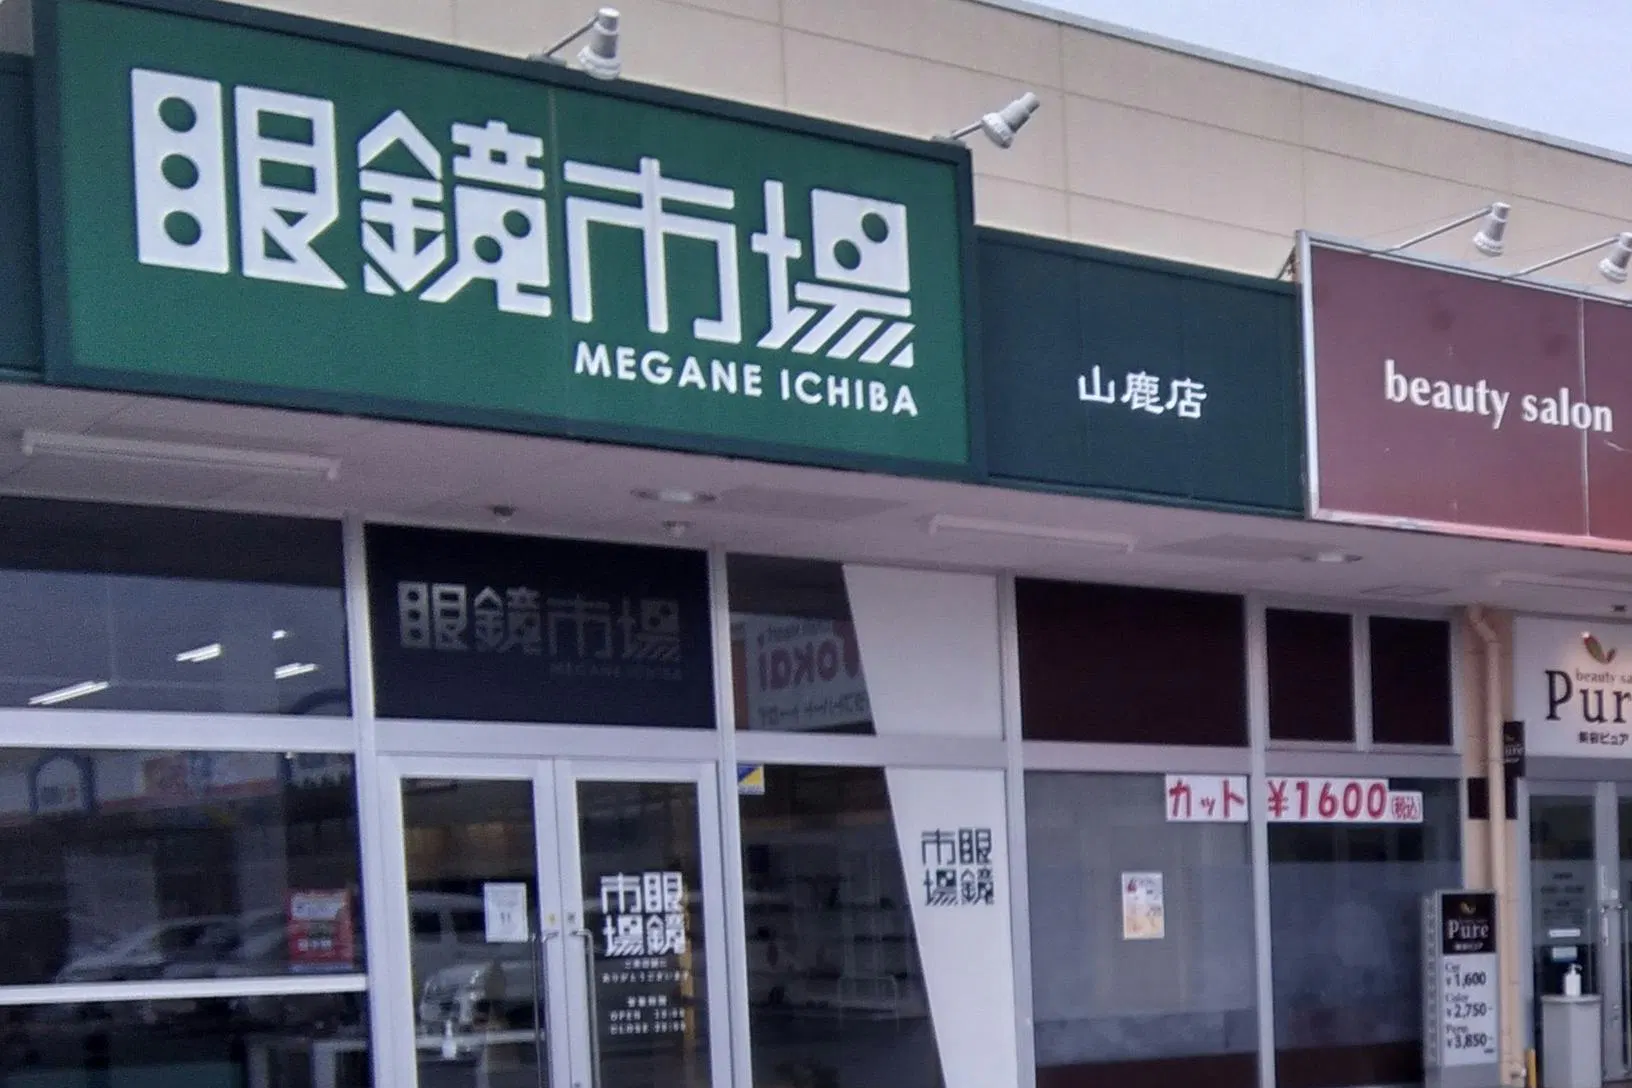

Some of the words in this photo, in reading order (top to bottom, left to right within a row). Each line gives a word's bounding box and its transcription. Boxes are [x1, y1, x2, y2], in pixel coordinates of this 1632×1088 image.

[130, 67, 916, 369] 眼鏡市場
[574, 340, 763, 398] MEGANE
[780, 369, 919, 417] ICHIBA
[1077, 364, 1208, 418] 山鹿店
[1385, 359, 1510, 428] beauty
[1521, 387, 1613, 432] salon
[397, 580, 681, 662] 眼鏡市場
[1575, 668, 1616, 684] beauty
[1168, 779, 1246, 818] カット
[1267, 780, 1389, 819] ¥1600
[1447, 918, 1490, 940] Pure
